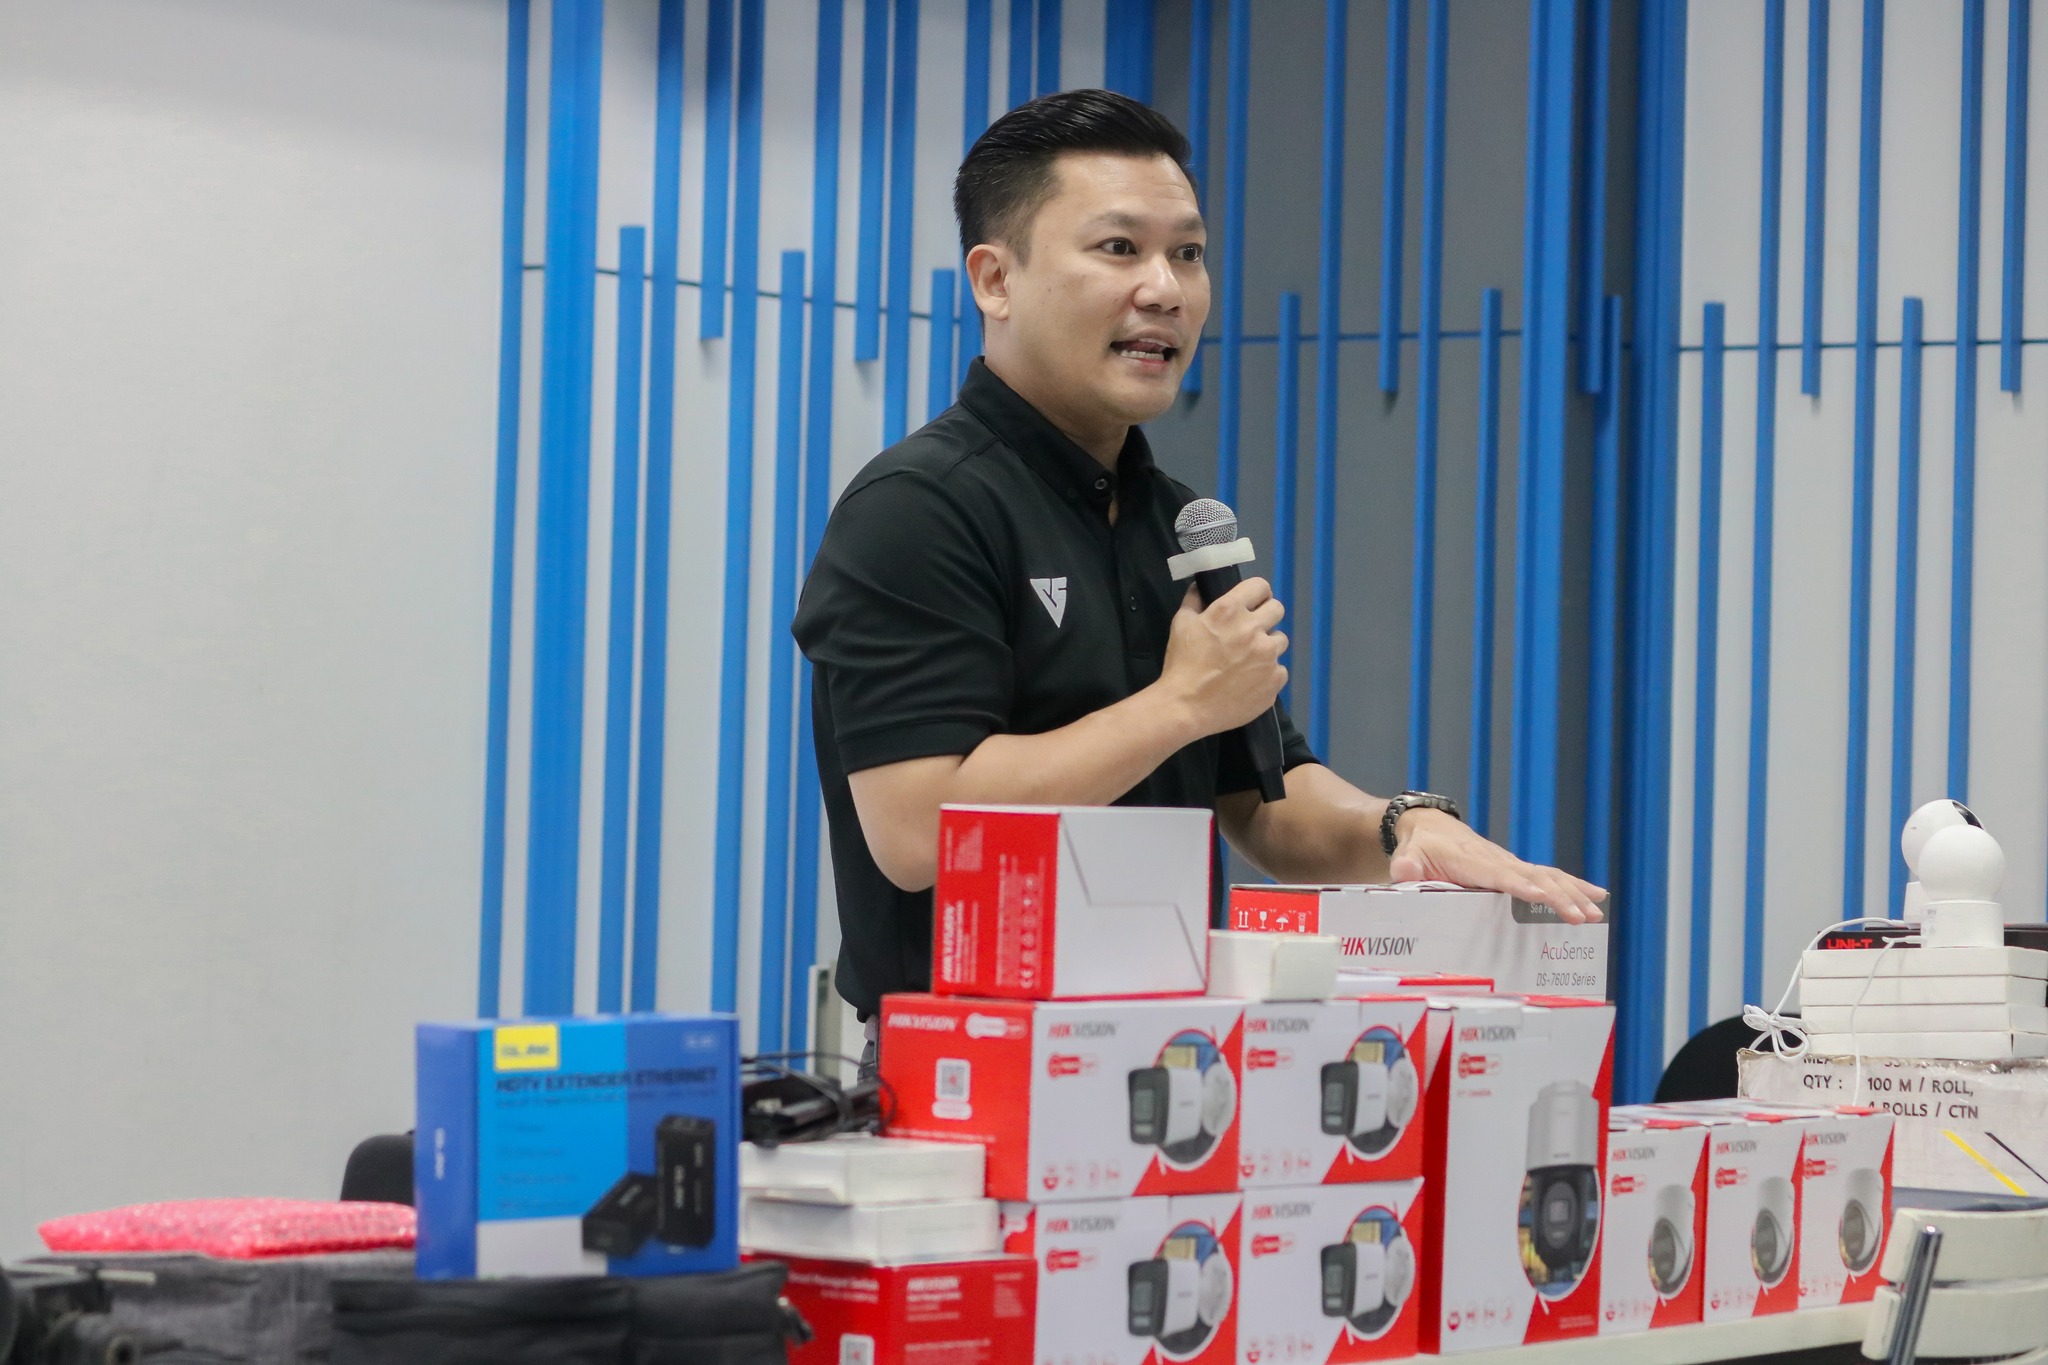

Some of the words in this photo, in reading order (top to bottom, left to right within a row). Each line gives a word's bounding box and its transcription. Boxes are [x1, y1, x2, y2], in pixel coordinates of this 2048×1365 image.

[1339, 937, 1415, 955] HIKVISION
[1540, 941, 1595, 960] AcuSense
[1826, 938, 1873, 949] UNI-T
[1536, 972, 1570, 987] DS-7600
[1572, 972, 1597, 986] Series
[1803, 1074, 1832, 1089] QTY
[1867, 1077, 1893, 1092] 100
[1898, 1078, 1912, 1093] M
[1932, 1080, 1974, 1097] ROLL,
[1882, 1102, 1928, 1117] ROLLS
[1948, 1104, 1979, 1119] CTN
